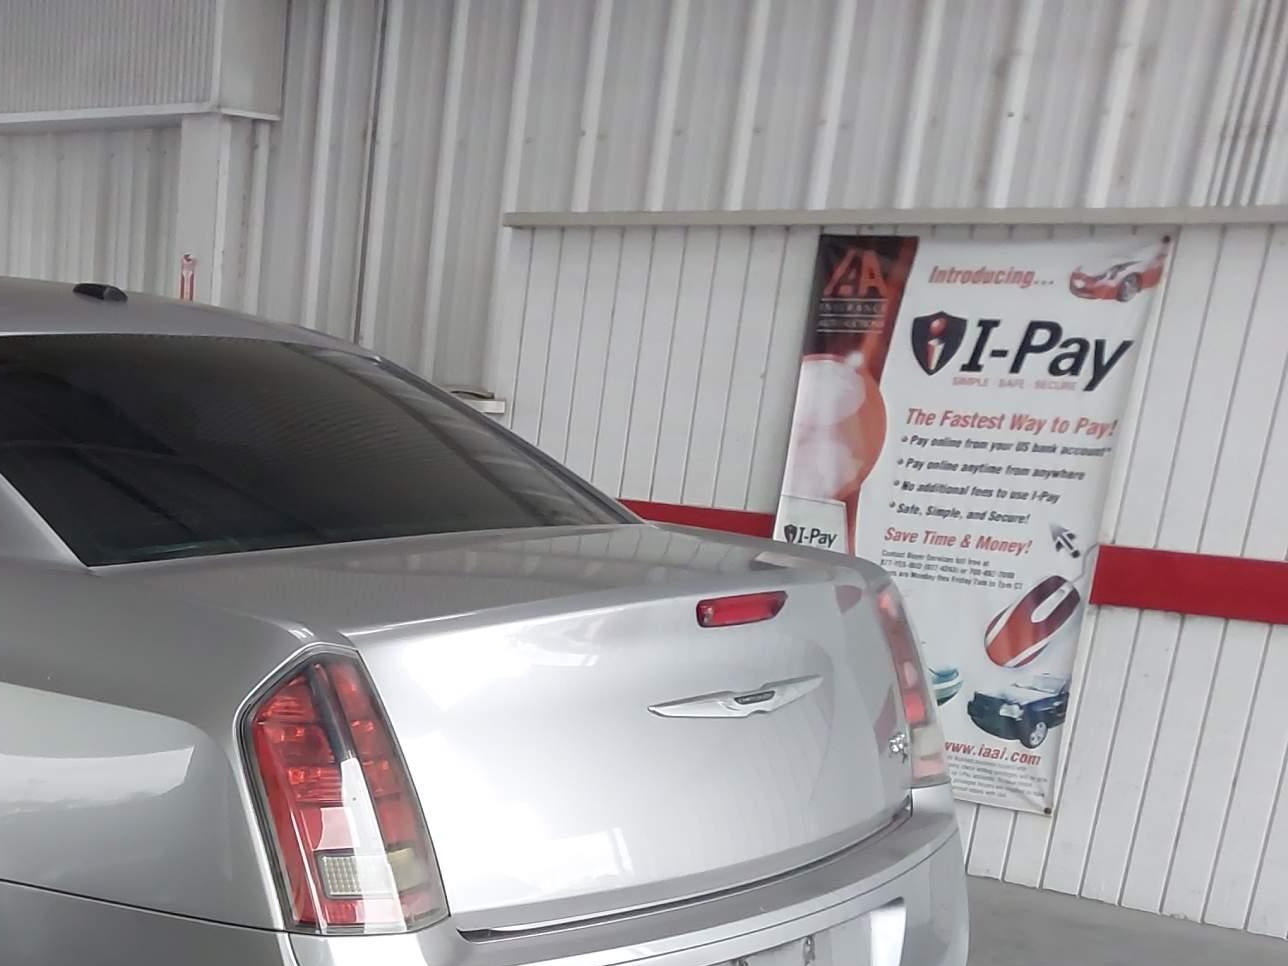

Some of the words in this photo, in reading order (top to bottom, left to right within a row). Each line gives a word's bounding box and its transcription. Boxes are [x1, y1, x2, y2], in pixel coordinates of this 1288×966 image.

[928, 266, 1054, 288] Introducing...
[959, 318, 1135, 392] I-Pay
[906, 408, 937, 426] The
[939, 410, 1006, 430] Fastest
[1009, 413, 1049, 436] Way
[1050, 416, 1071, 434] to
[1073, 416, 1119, 440] Pay!
[909, 434, 930, 448] Pay
[930, 437, 963, 449] online
[964, 438, 989, 449] from
[989, 441, 1014, 453] your
[1015, 441, 1031, 452] US
[1031, 443, 1058, 454] bank
[905, 457, 925, 471] Pay
[926, 460, 960, 472] online
[960, 463, 1003, 475] anytime
[1004, 464, 1031, 476] from
[1031, 468, 1086, 481] anywhere
[901, 480, 915, 492] No
[916, 482, 970, 496] additional
[970, 486, 994, 498] fees
[995, 488, 1009, 499] to
[1009, 491, 1030, 501] use
[1031, 490, 1061, 505] I-Pay
[896, 503, 923, 517] Safe,
[925, 505, 963, 520] Simple,
[965, 511, 988, 521] and
[988, 510, 1032, 524] Secure!
[797, 526, 839, 549] I-Pay
[884, 526, 920, 544] Save
[922, 530, 958, 547] Time
[959, 533, 972, 549] &
[974, 534, 1033, 557] Money!
